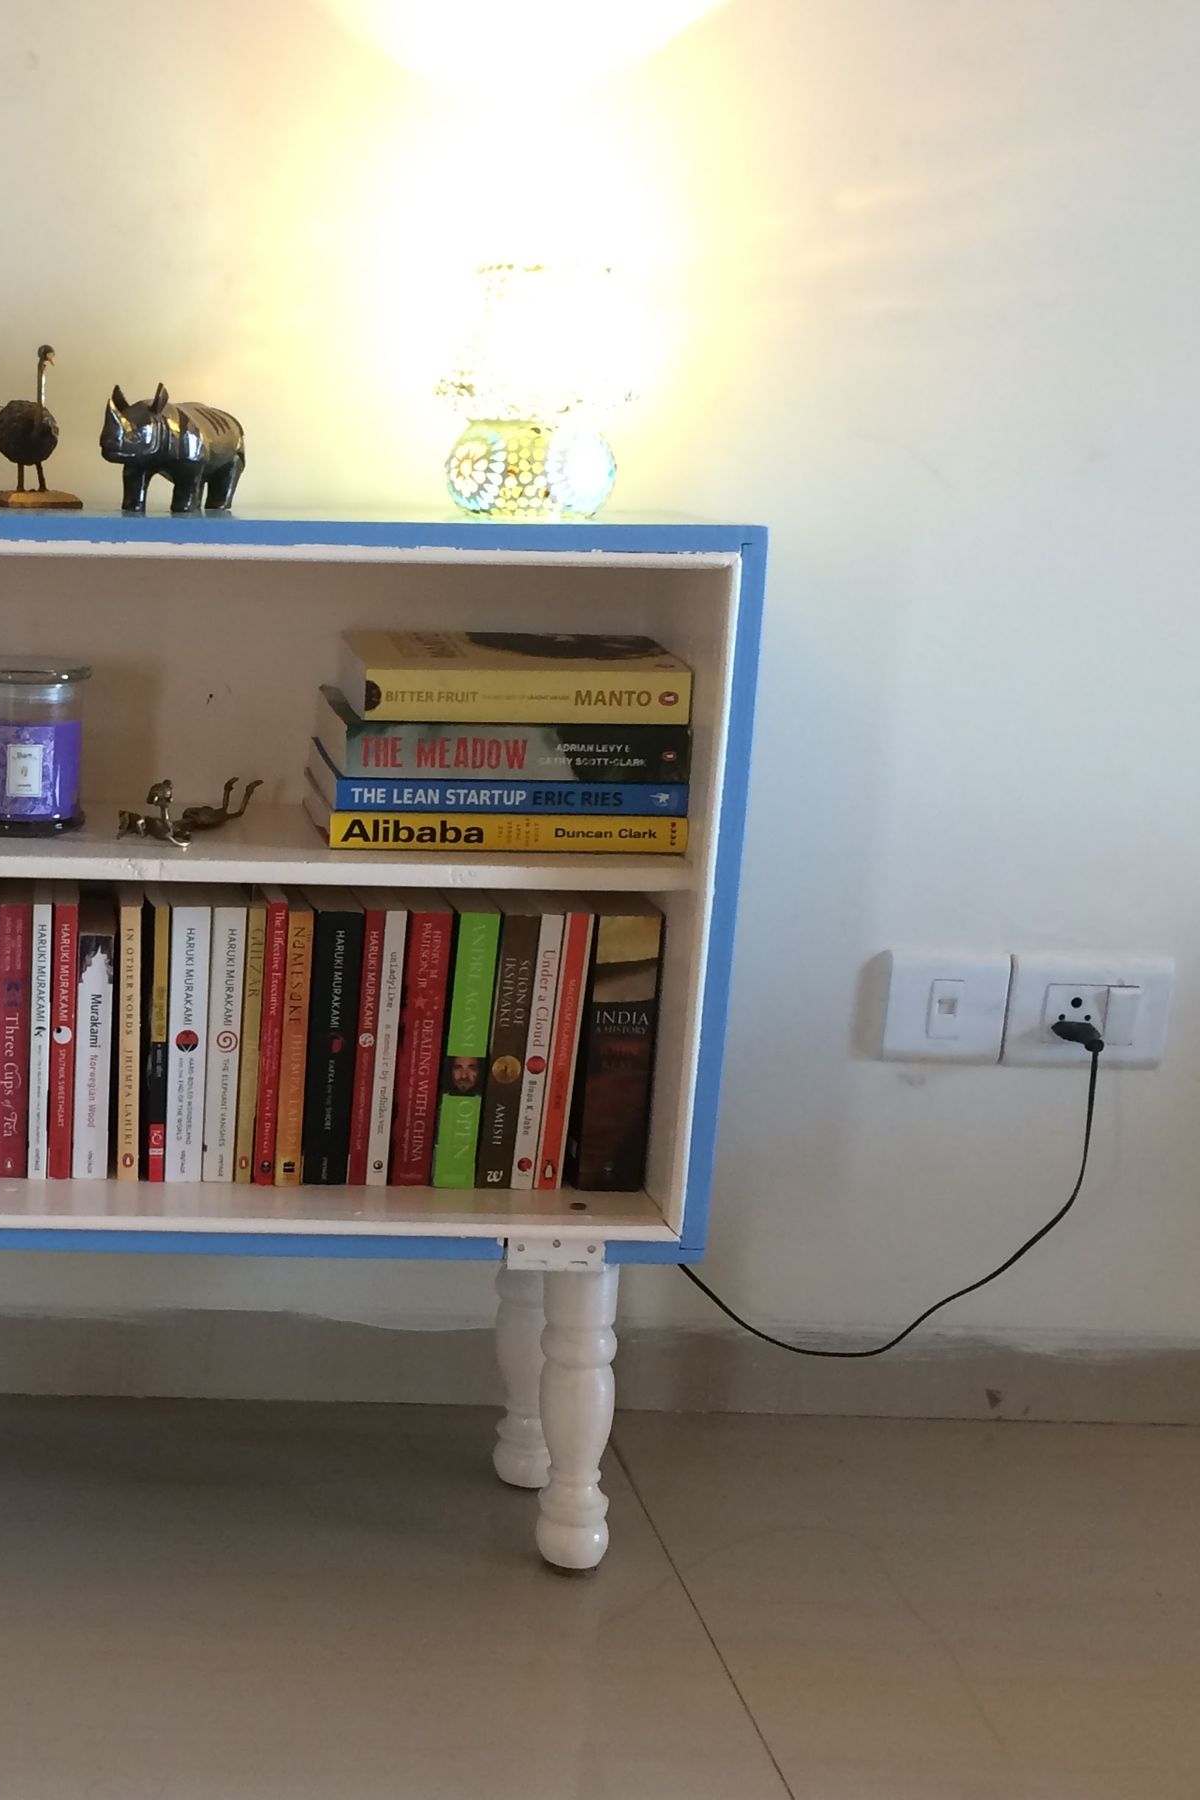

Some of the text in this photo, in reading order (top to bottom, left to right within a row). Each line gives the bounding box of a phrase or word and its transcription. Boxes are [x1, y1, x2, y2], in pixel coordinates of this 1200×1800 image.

[385, 690, 435, 703] BITTER
[438, 691, 479, 703] FRUIT
[574, 690, 652, 707] MANTO
[361, 737, 528, 770] THE MEADOW
[555, 743, 623, 753] ADRIAN LEVY
[351, 787, 623, 807] THE LEAN STARTUP ERIC RIES
[340, 818, 484, 844] Alibaba
[554, 828, 612, 839] Duncan
[618, 828, 657, 839] Clark
[274, 910, 286, 927] The
[247, 928, 265, 998] GULZAR
[271, 932, 284, 970] Effective
[431, 930, 443, 966] HENRY
[35, 924, 47, 1022] HARUKI MURAKAMI
[58, 924, 71, 1022] HARUKI MURAKAMI
[125, 928, 135, 1036] IN OTHER WORDS
[183, 928, 196, 1026] HARUKI MURAKAMI
[224, 928, 238, 1027] HARUKI MURAKAMI
[330, 930, 345, 1028] HARUKI MURAKAMI
[363, 930, 380, 1029] HARUKI MURAKAMI
[386, 951, 398, 1012] unladylike.
[540, 950, 556, 991] Under
[269, 972, 282, 1016] Executive
[500, 958, 514, 1028] IKSHVAKU
[512, 959, 530, 1025] SCION OF
[562, 979, 577, 1021] MALCOLM
[4, 1013, 19, 1057] Three
[89, 994, 102, 1048] Murakami
[532, 1006, 551, 1048] Cloud
[596, 1010, 649, 1026] INDIA
[604, 1026, 647, 1036] HISTORY
[418, 1019, 435, 1076] DEALING
[454, 924, 487, 1159] ANDRE AGASSI OPEN
[0, 1062, 22, 1096] Cups
[222, 1058, 230, 1071] THE
[326, 1059, 336, 1083] KAFKA
[379, 1070, 390, 1081] by
[57, 1049, 67, 1128] SPUTNIK SWEETHEART
[87, 1054, 99, 1128] Norwegian Wood
[123, 1050, 133, 1145] JHUMPA LAHIRI
[220, 1074, 230, 1111] ELEPHANT
[414, 1080, 428, 1118] WITH
[3, 1111, 18, 1137] Tea
[410, 1120, 426, 1163] CHINA
[491, 1104, 506, 1145] AMISH
